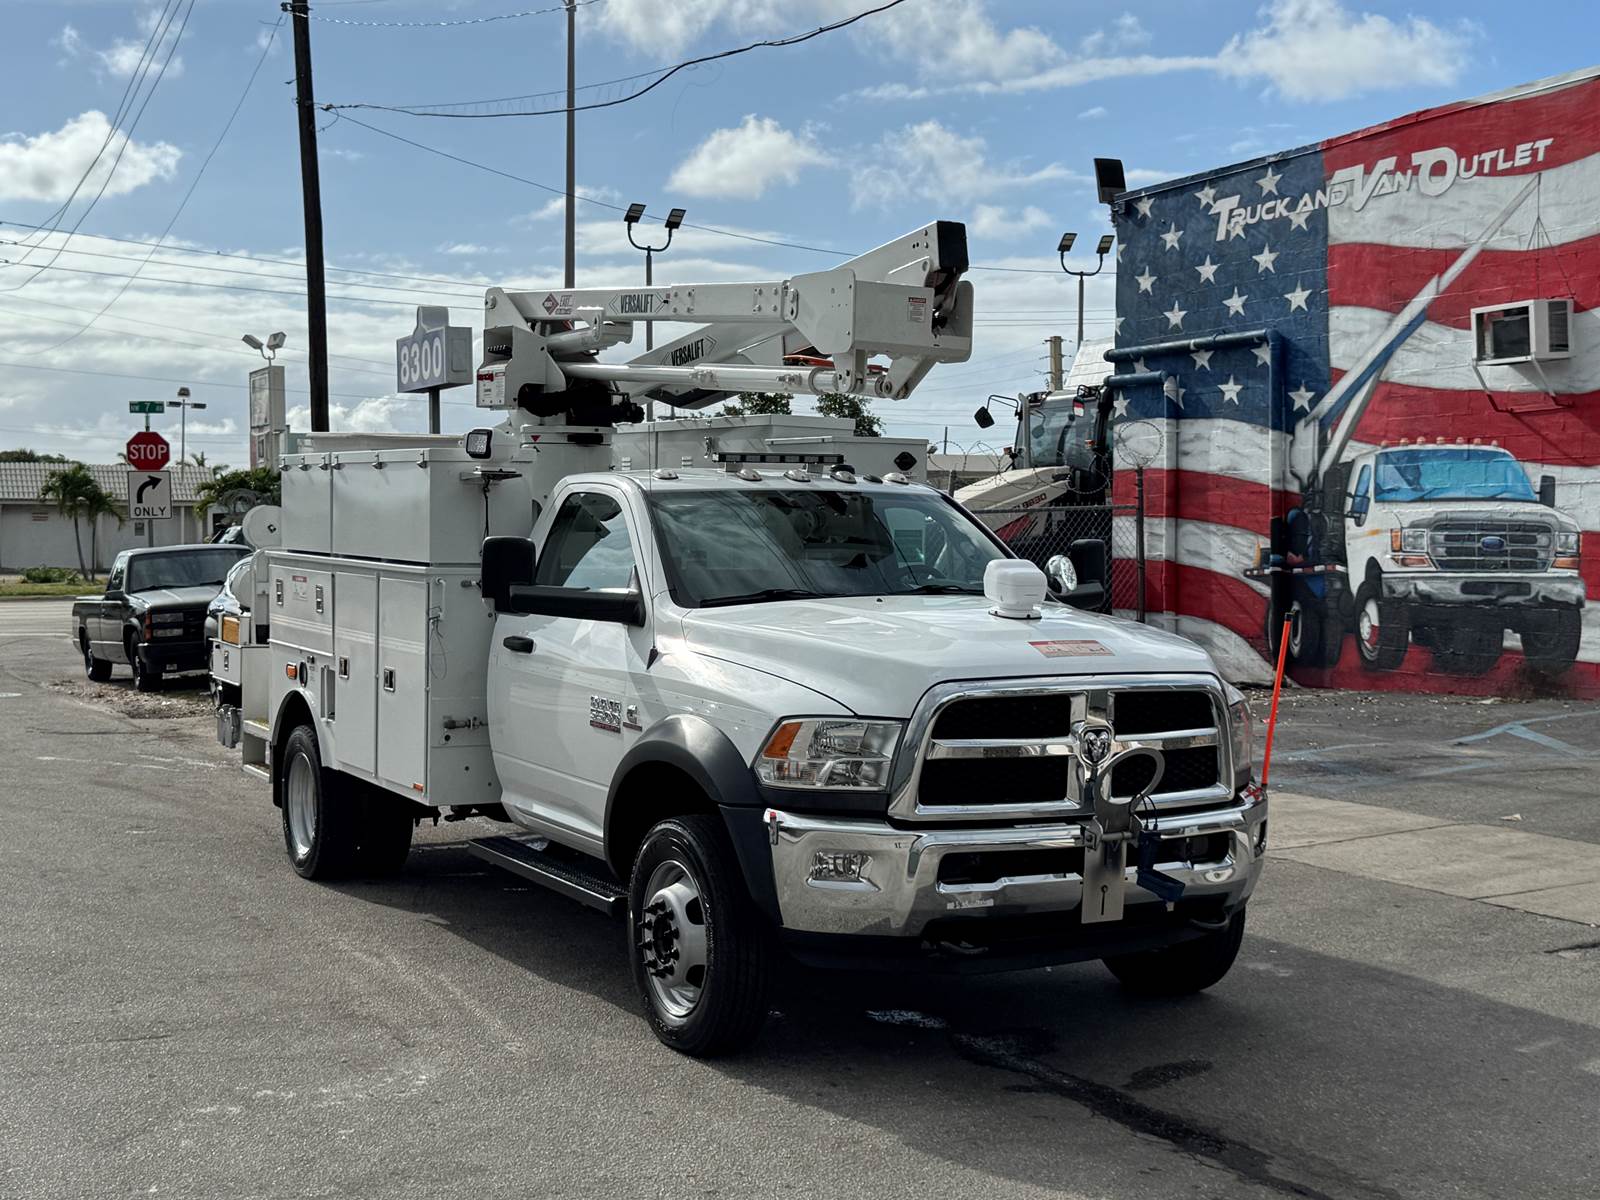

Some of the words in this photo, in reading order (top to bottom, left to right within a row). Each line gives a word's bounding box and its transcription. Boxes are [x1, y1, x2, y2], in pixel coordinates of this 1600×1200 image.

[1208, 194, 1291, 242] TRUCK
[1294, 183, 1348, 214] AND
[1331, 156, 1412, 212] VAN
[1411, 138, 1554, 197] OUTLET
[620, 294, 654, 314] VERSALIFT
[400, 336, 442, 385] 8300
[670, 338, 705, 367] VERSALIFT
[129, 444, 168, 460] STOP
[134, 506, 166, 517] ONLY
